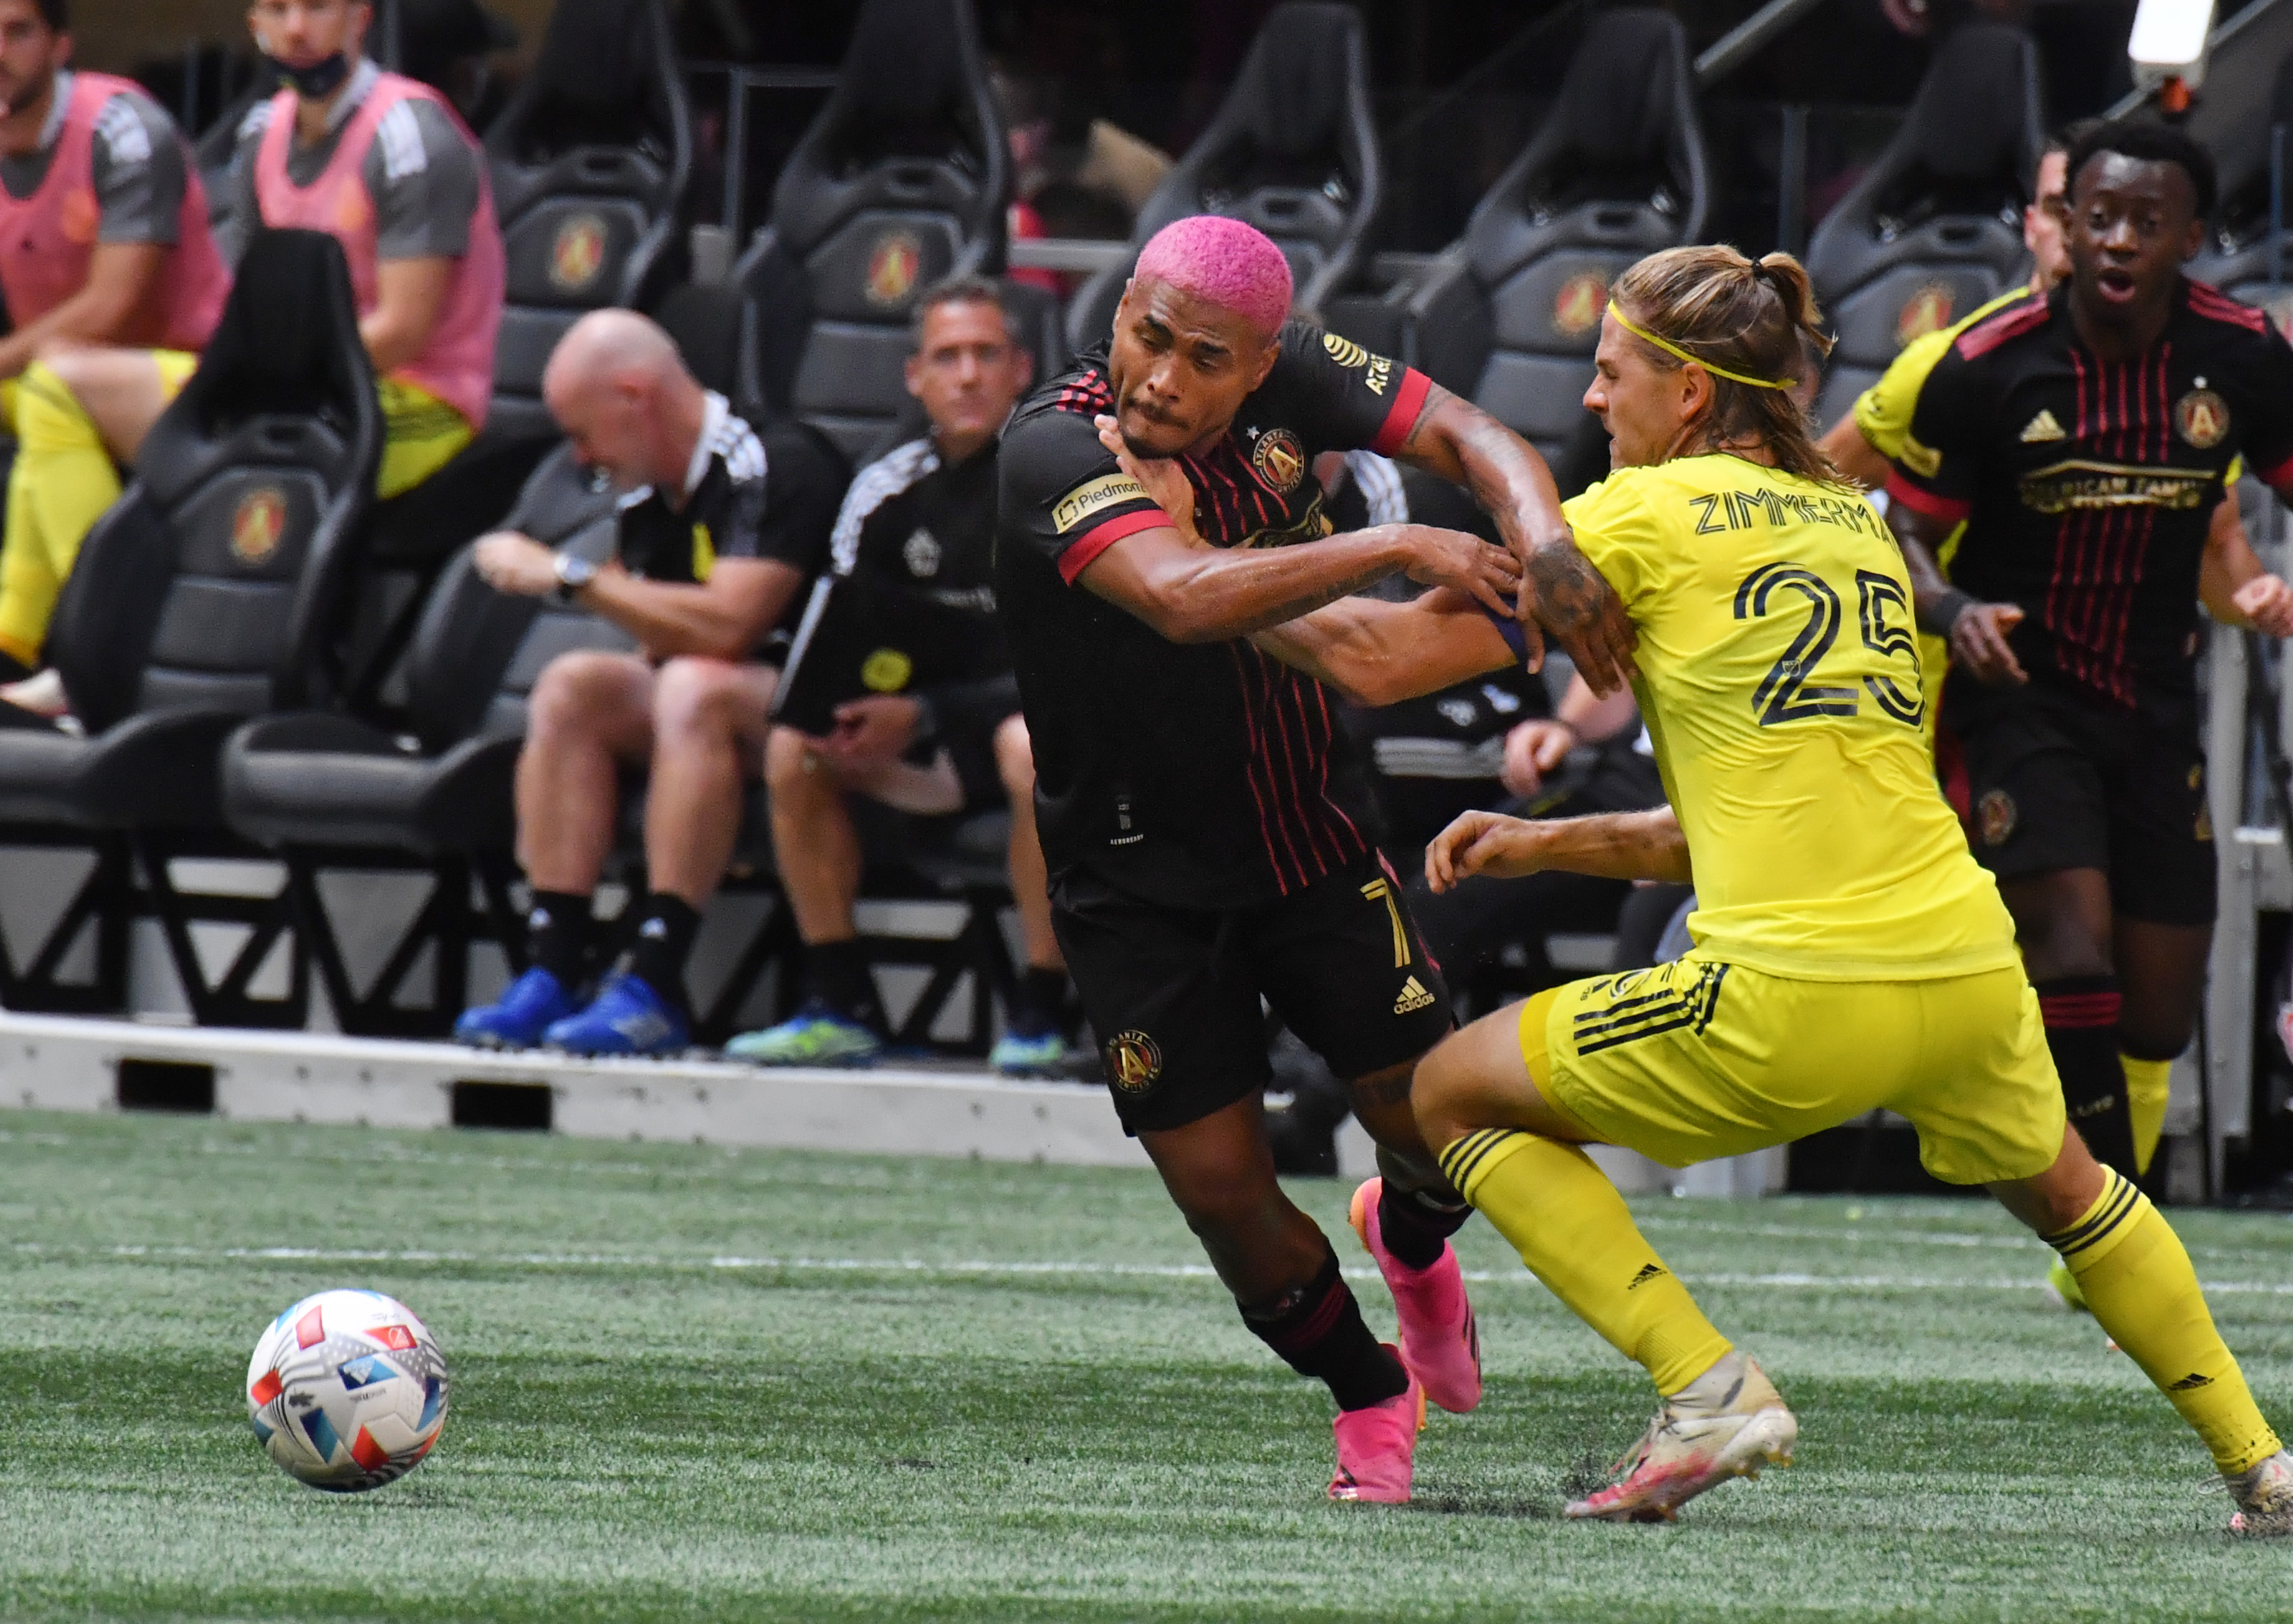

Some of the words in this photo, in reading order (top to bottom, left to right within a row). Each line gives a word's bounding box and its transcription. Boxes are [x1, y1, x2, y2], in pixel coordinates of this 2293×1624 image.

[1255, 430, 1284, 466] ATLANTA
[1734, 561, 1926, 732] 25
[1110, 833, 1144, 845] AEROREADY
[1359, 877, 1411, 968] 7
[1394, 993, 1435, 1015] adidas
